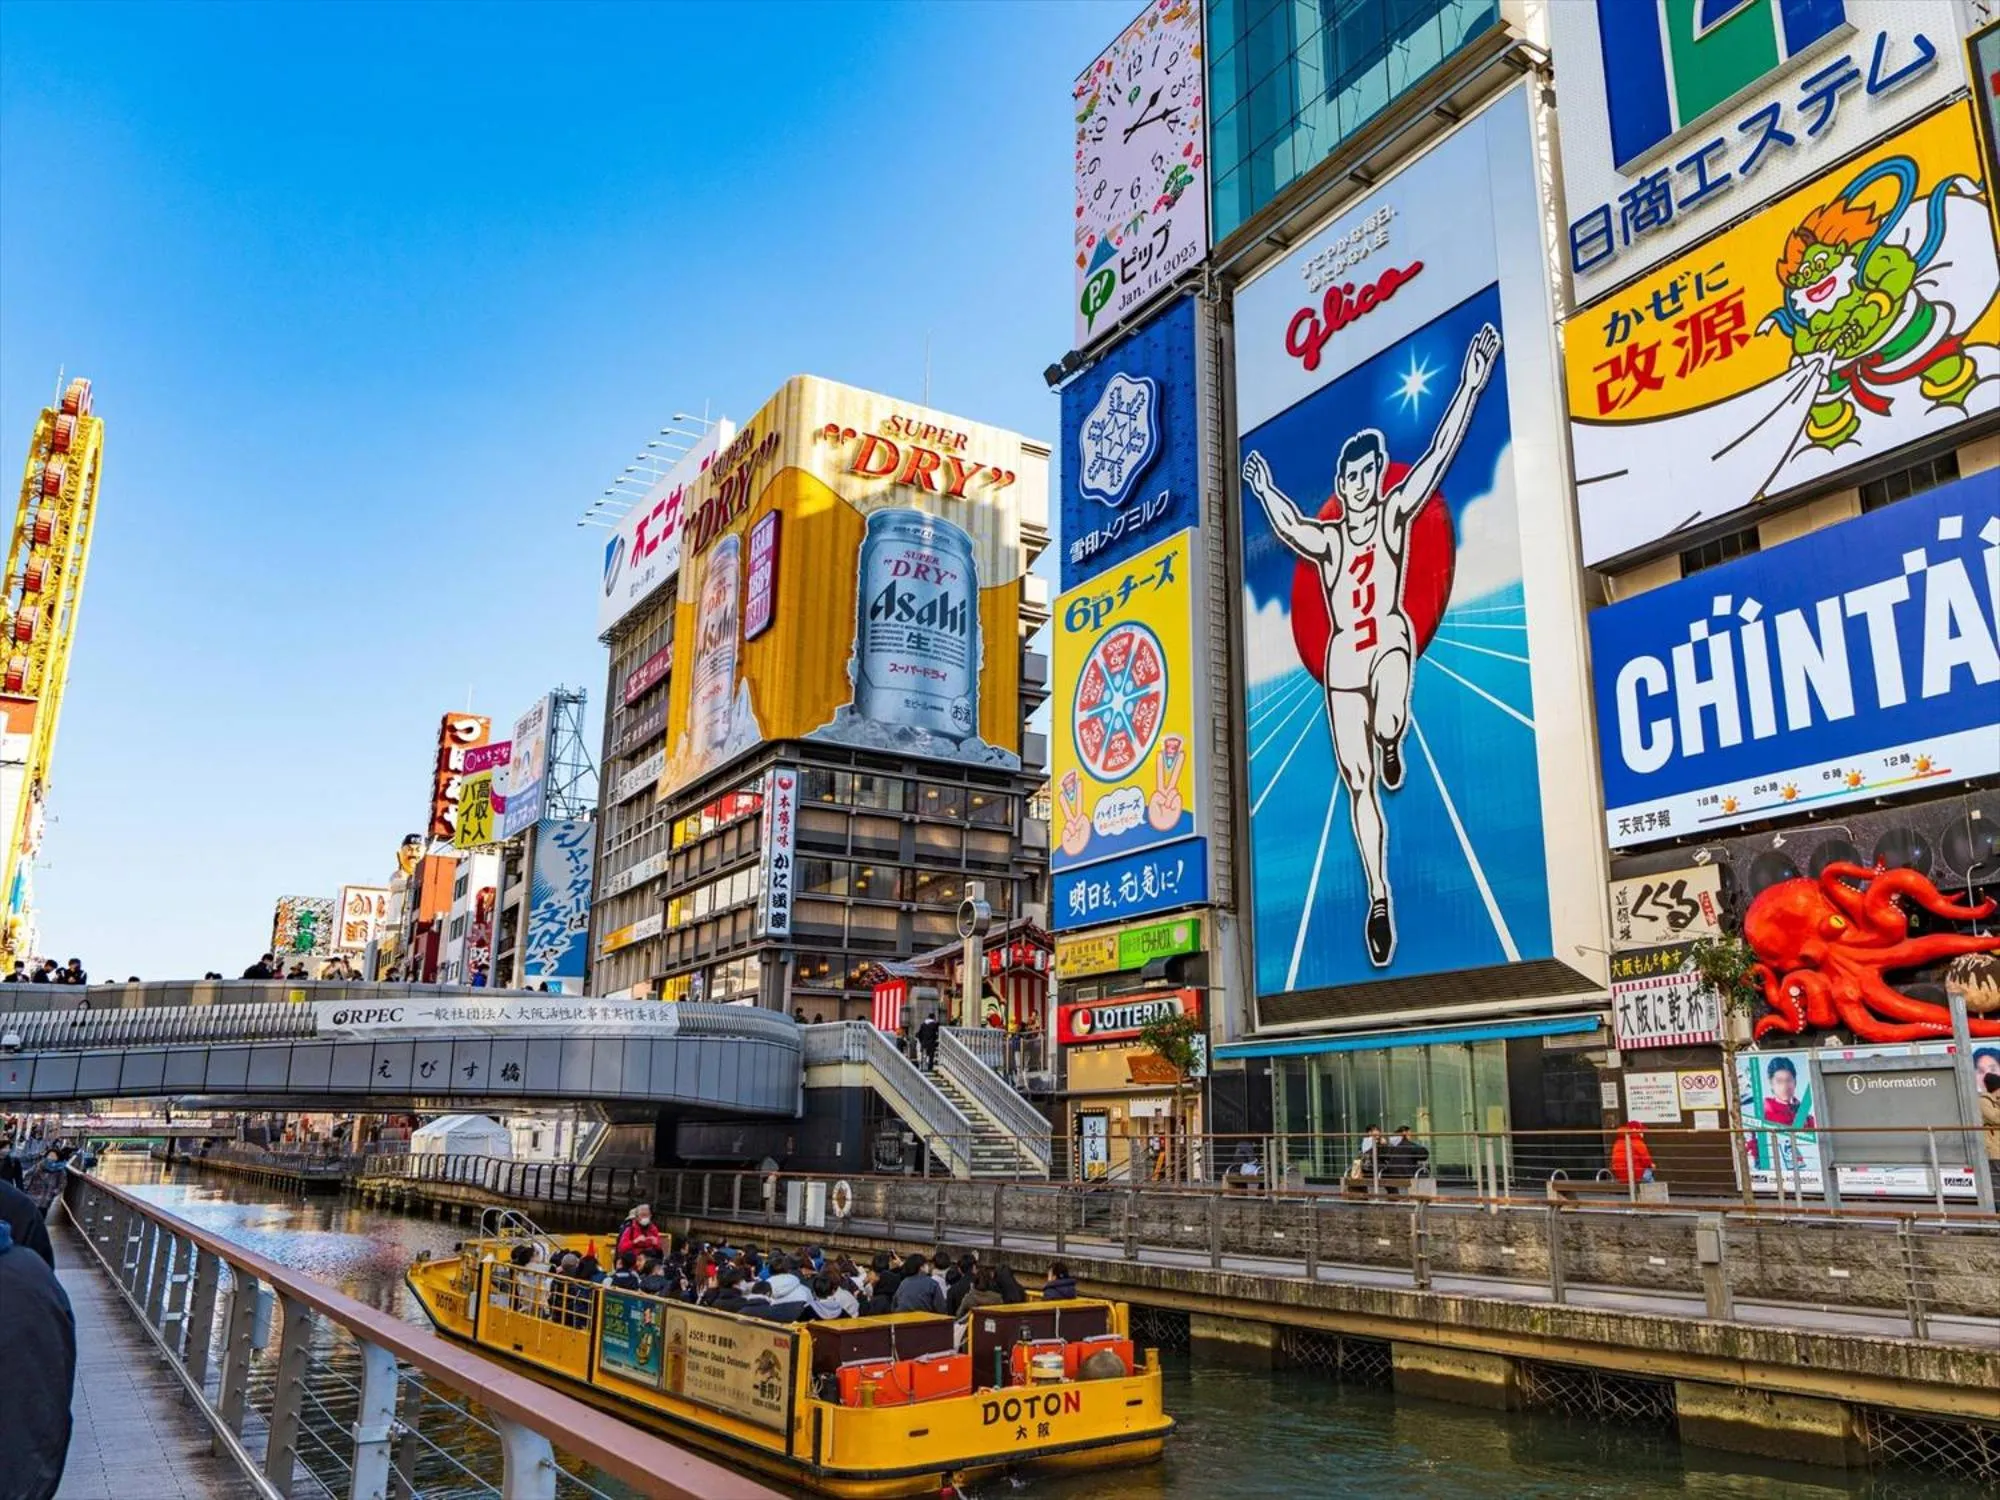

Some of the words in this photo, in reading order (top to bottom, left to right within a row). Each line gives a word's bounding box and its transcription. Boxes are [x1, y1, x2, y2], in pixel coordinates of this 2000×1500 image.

[1126, 54, 1143, 83] 12
[1151, 45, 1160, 68] 1
[1164, 52, 1179, 75] 2
[1106, 83, 1122, 107] 11
[1171, 78, 1186, 98] 3
[1092, 116, 1108, 145] 10
[1167, 113, 1181, 134] 4
[1151, 152, 1164, 172] 5
[1569, 31, 1937, 274] 日商エステム
[1088, 156, 1101, 176] 9
[1093, 179, 1107, 201] 8
[1109, 188, 1123, 210] 7
[1130, 177, 1141, 200] 6
[1120, 219, 1172, 285] ピップ
[1118, 287, 1145, 311] Jan.
[1148, 270, 1161, 289] 11.
[1163, 240, 1197, 274] 2025
[1285, 260, 1424, 371] Glico
[1603, 260, 1730, 348] かぜに
[1592, 288, 1752, 415] 改源
[886, 414, 969, 451] SUPER
[711, 428, 755, 486] SUPER
[1069, 490, 1170, 564] 雪印メグミルク
[903, 550, 940, 565] SUPER
[870, 580, 967, 637] Asahi
[1348, 543, 1378, 652] グリコ
[907, 632, 931, 652] 生
[889, 662, 948, 681] スーパードライ
[1882, 753, 1910, 768] 12時
[1822, 768, 1842, 781] 6時
[1696, 794, 1719, 807] 18時
[1753, 782, 1778, 795] 24時
[474, 780, 491, 841] 高収入
[777, 795, 790, 849] 本場の味
[1618, 809, 1671, 837] 天気予報
[1631, 879, 1700, 932] くくる
[418, 1007, 511, 1021] 一般社団法人
[1094, 1002, 1171, 1029] LOTTERIA
[1620, 987, 1704, 1036] 大阪に乾杯
[376, 1060, 522, 1083] えびす橋
[1868, 1076, 1937, 1089] information
[982, 1390, 1081, 1425] DOTON
[1015, 1422, 1051, 1440] 大阪
